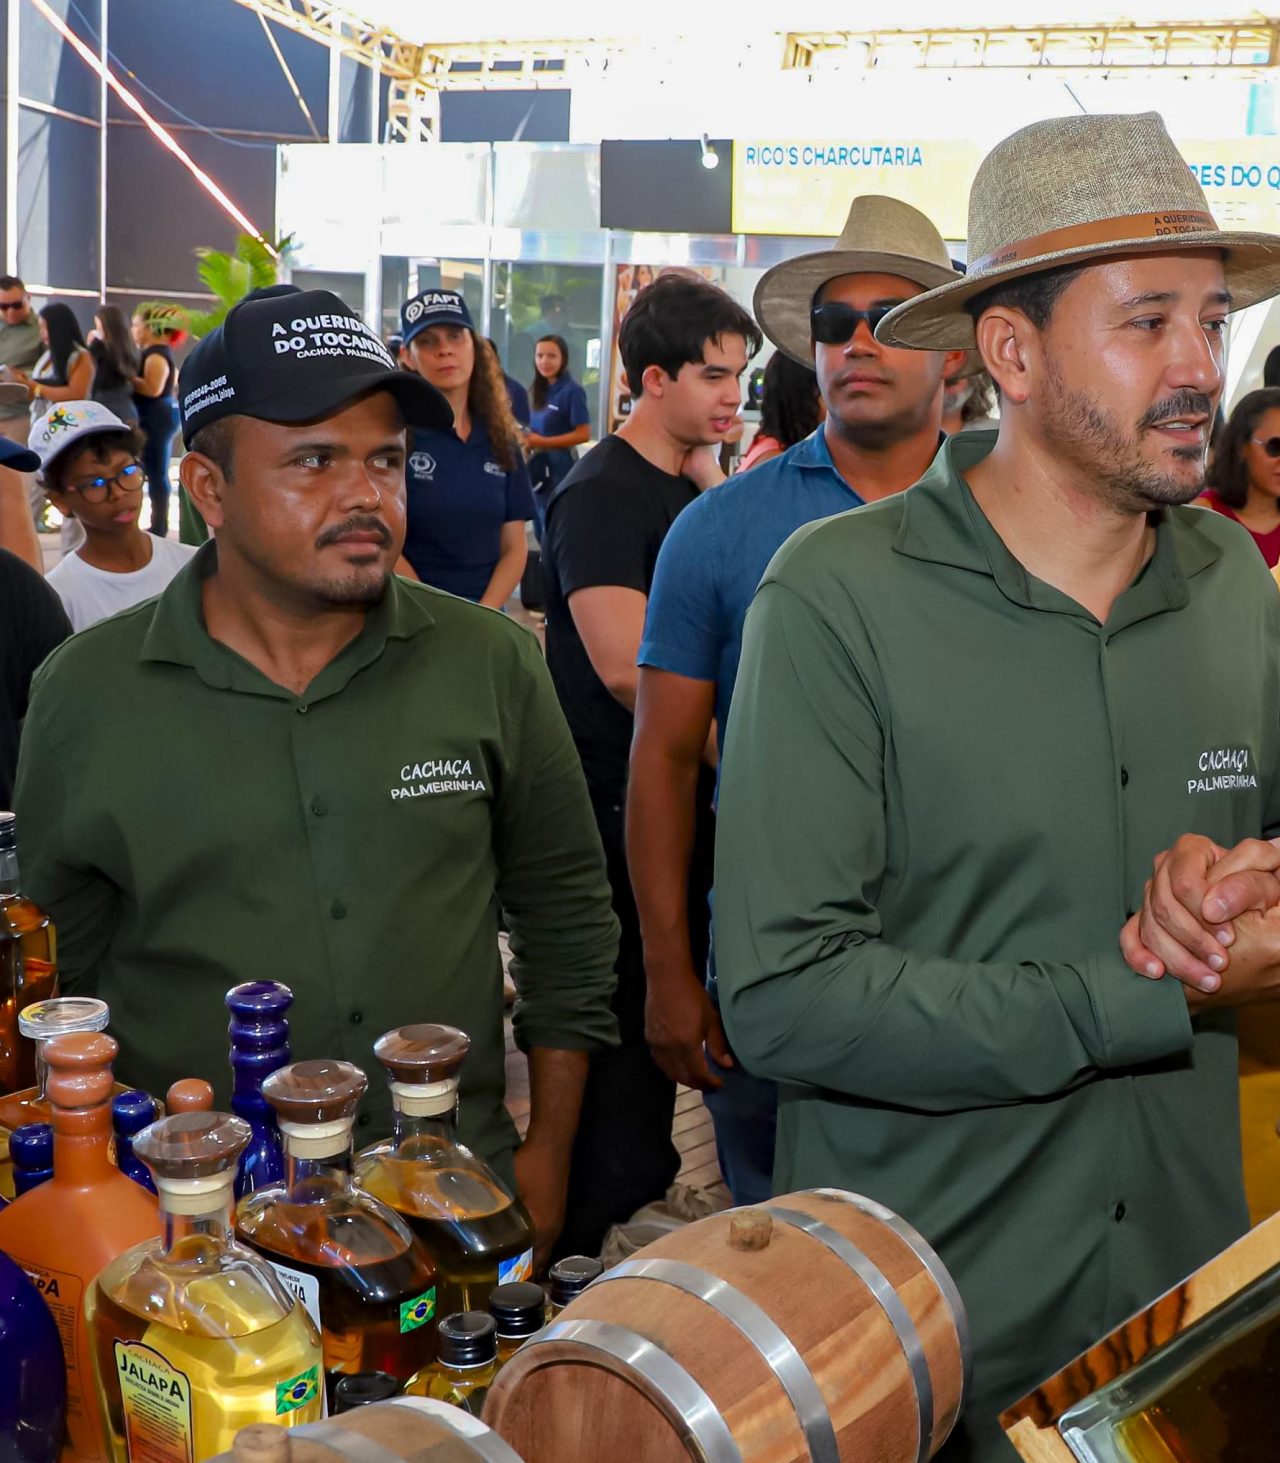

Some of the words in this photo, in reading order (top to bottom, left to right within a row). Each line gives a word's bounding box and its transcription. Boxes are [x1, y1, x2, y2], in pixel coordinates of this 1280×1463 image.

[746, 146, 799, 166] RICO'S
[802, 146, 923, 166] CHARCUTARIA
[1231, 165, 1262, 188] DO
[1154, 216, 1161, 226] A
[1156, 228, 1171, 236] DO
[423, 293, 460, 306] FAPT
[272, 322, 287, 337] A
[274, 336, 306, 355] DO
[297, 348, 344, 359] CACHAÇA
[400, 759, 473, 781] CACHAÇA
[1198, 748, 1248, 773] CACHAÇA
[390, 780, 486, 800] PALMEIRINHA
[120, 1354, 184, 1402] JALAPA
